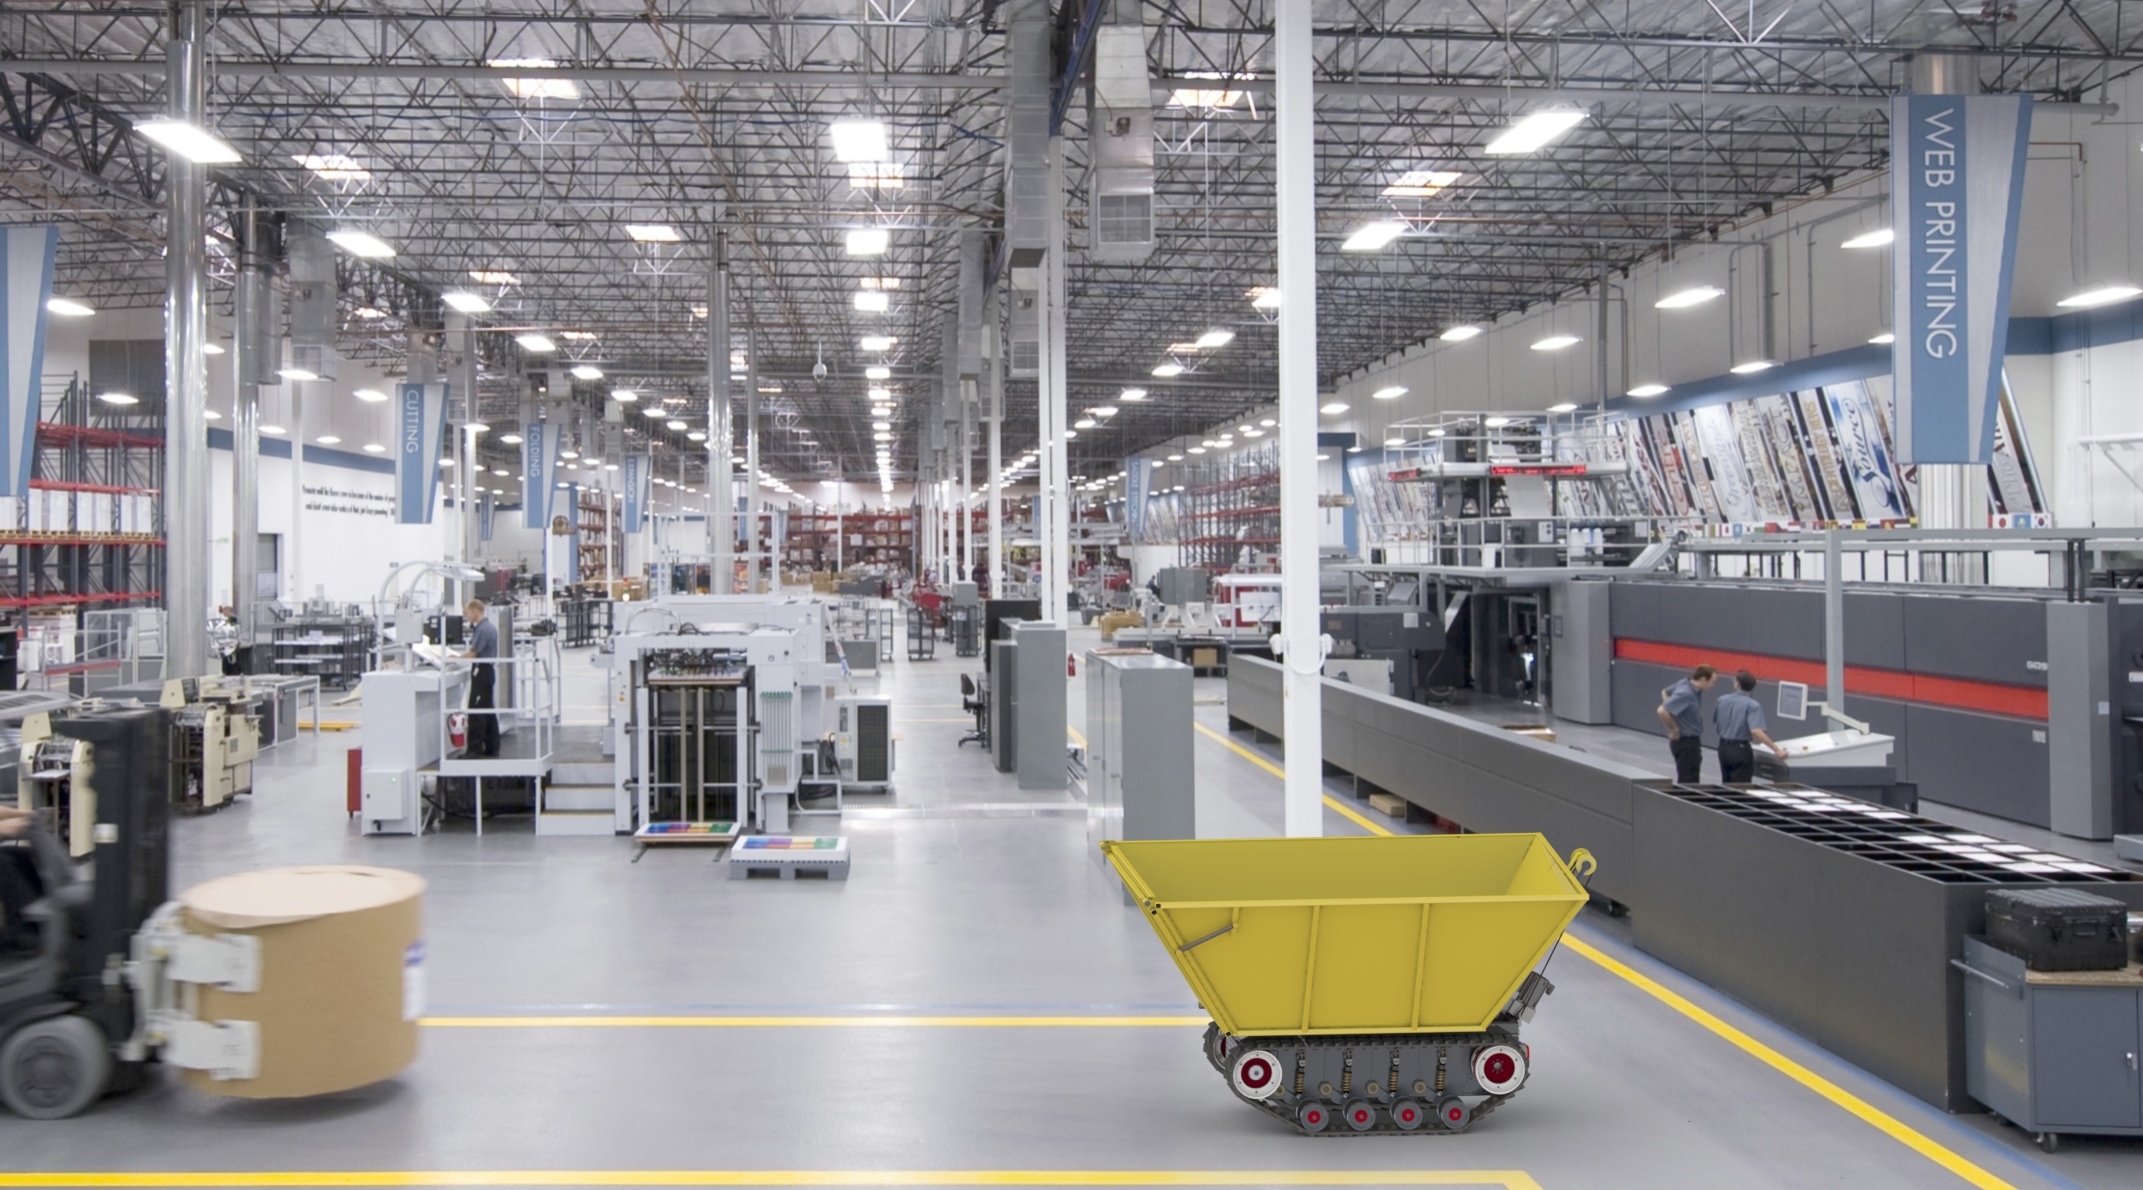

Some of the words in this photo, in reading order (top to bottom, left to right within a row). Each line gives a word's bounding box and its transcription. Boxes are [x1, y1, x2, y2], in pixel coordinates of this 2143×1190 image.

[1924, 108, 1955, 188] WEB
[1924, 201, 1957, 359] PRINTING
[406, 389, 419, 453] CUTTING
[530, 427, 540, 477] FOLDING
[1768, 406, 1812, 511] IMPACT
[1843, 398, 1880, 488] Source
[627, 459, 635, 503] EXPANSION
